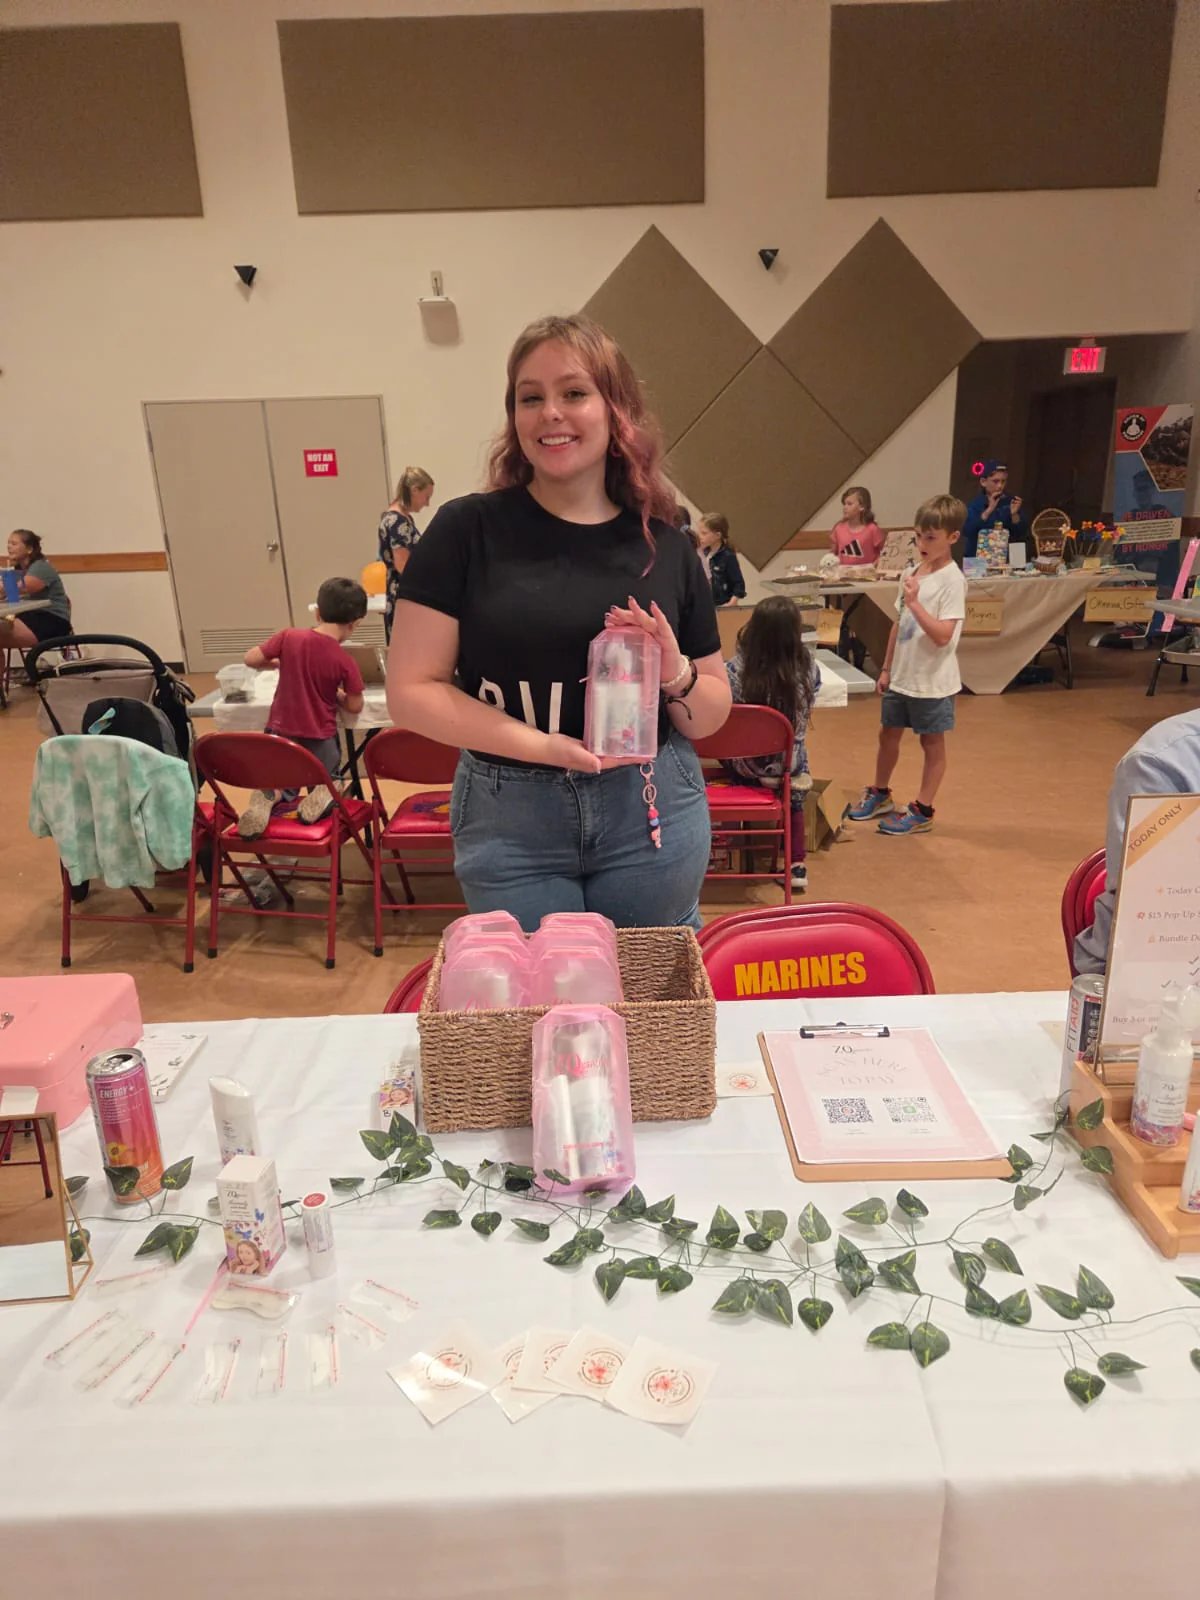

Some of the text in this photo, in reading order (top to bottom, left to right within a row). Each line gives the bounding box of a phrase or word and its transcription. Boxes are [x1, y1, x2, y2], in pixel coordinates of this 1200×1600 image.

[1071, 347, 1102, 371] EXIT
[307, 453, 333, 462] NOT AN
[313, 464, 329, 472] EXIT
[1136, 510, 1171, 520] DRIVEN
[1121, 541, 1169, 553] BY HONOR
[1128, 803, 1183, 852] TODAY ONLY
[1167, 887, 1193, 896] Today
[1148, 911, 1161, 919] $15
[734, 951, 867, 996] MARINES
[1067, 997, 1079, 1053] FITAID
